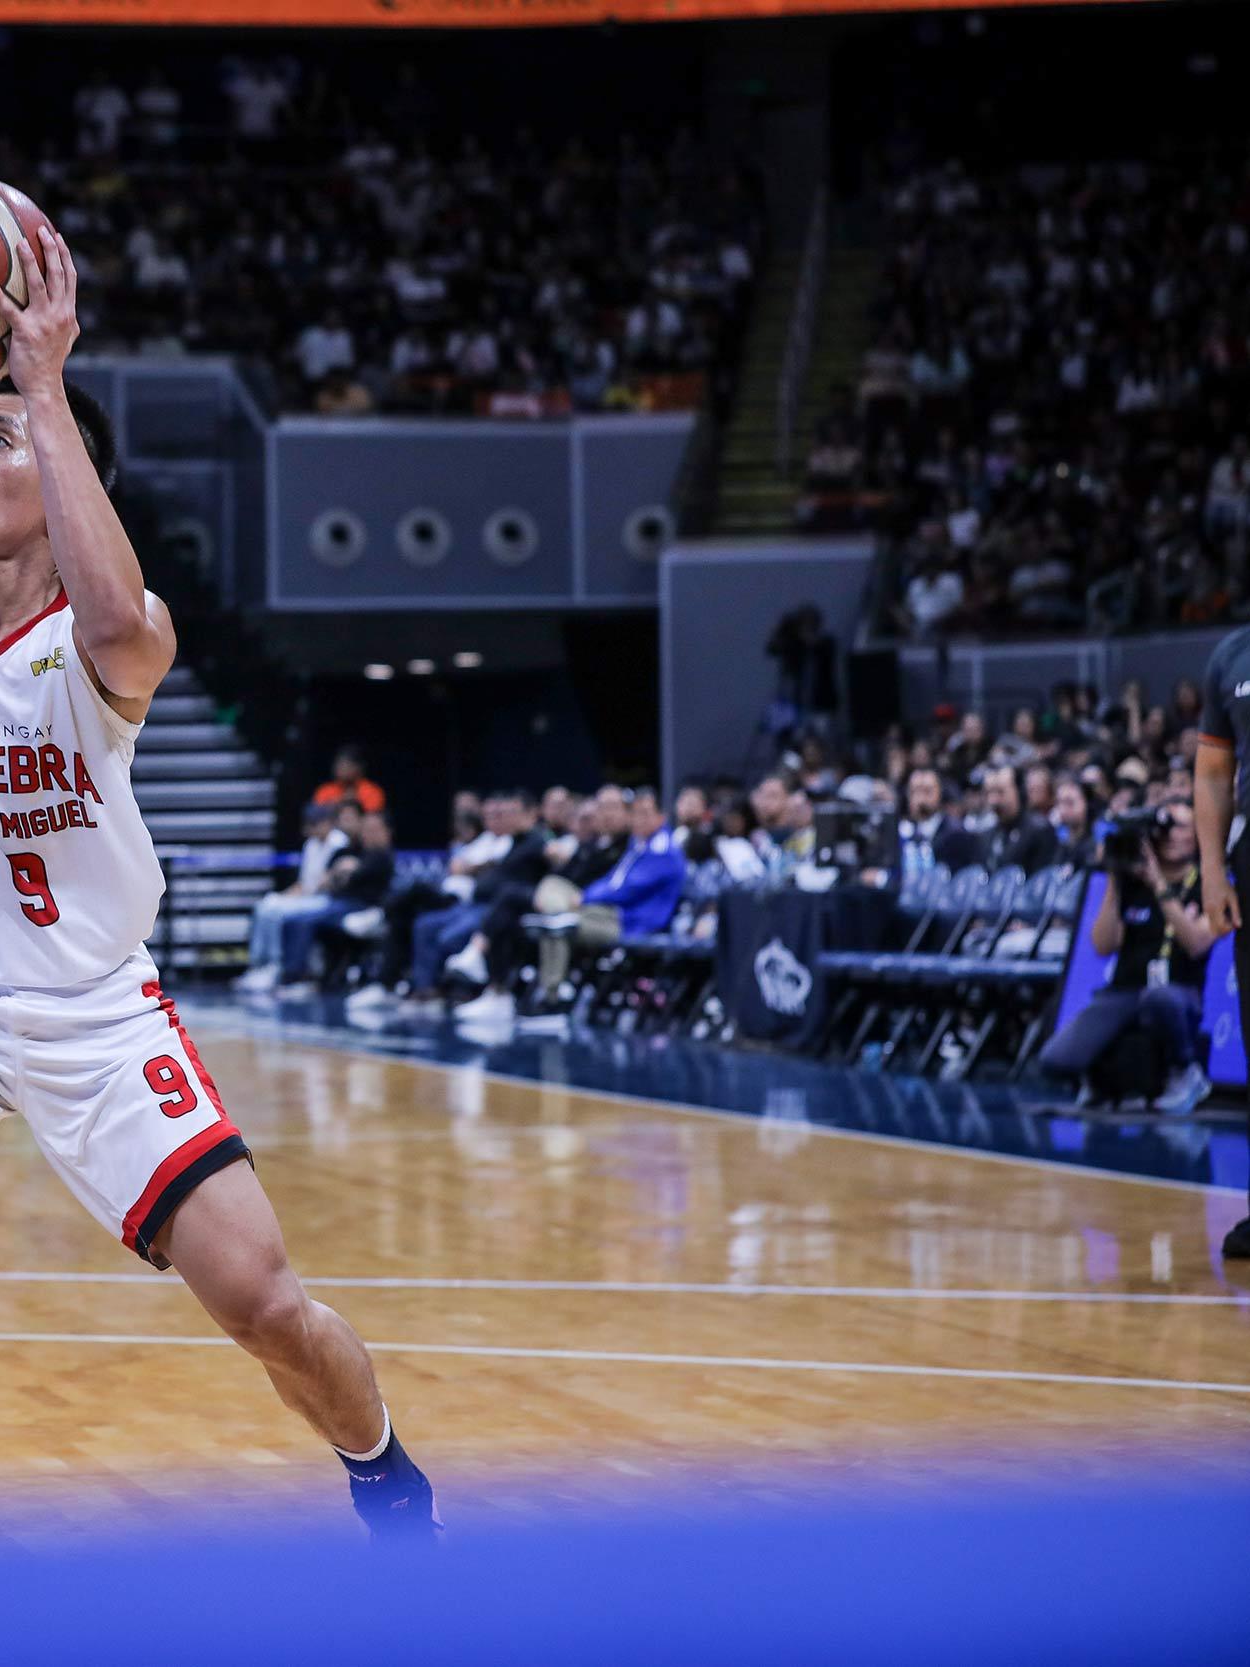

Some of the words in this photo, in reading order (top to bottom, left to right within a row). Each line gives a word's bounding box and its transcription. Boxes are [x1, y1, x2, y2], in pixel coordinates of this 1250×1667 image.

[0, 800, 97, 839] MIGUEL
[6, 852, 60, 927] 9
[143, 1054, 197, 1118] 9
